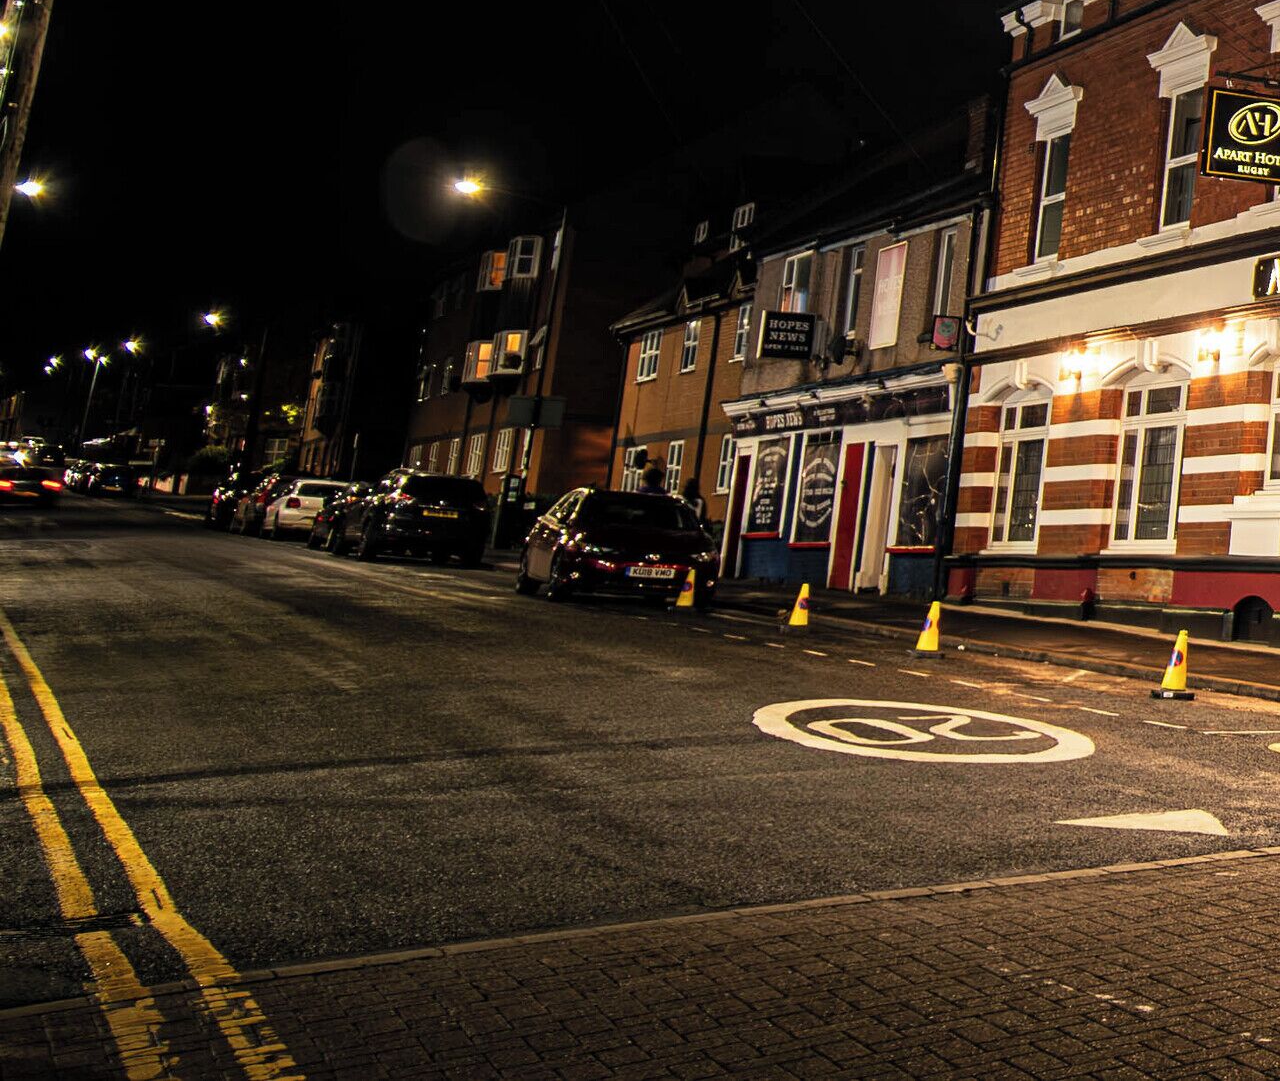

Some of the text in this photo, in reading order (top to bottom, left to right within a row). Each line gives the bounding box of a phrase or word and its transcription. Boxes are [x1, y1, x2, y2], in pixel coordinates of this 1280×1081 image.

[1213, 147, 1252, 162] APART
[1237, 165, 1270, 176] RUGBY
[768, 319, 810, 331] HOPES
[769, 331, 806, 343] NEWS
[806, 713, 1044, 746] 20
